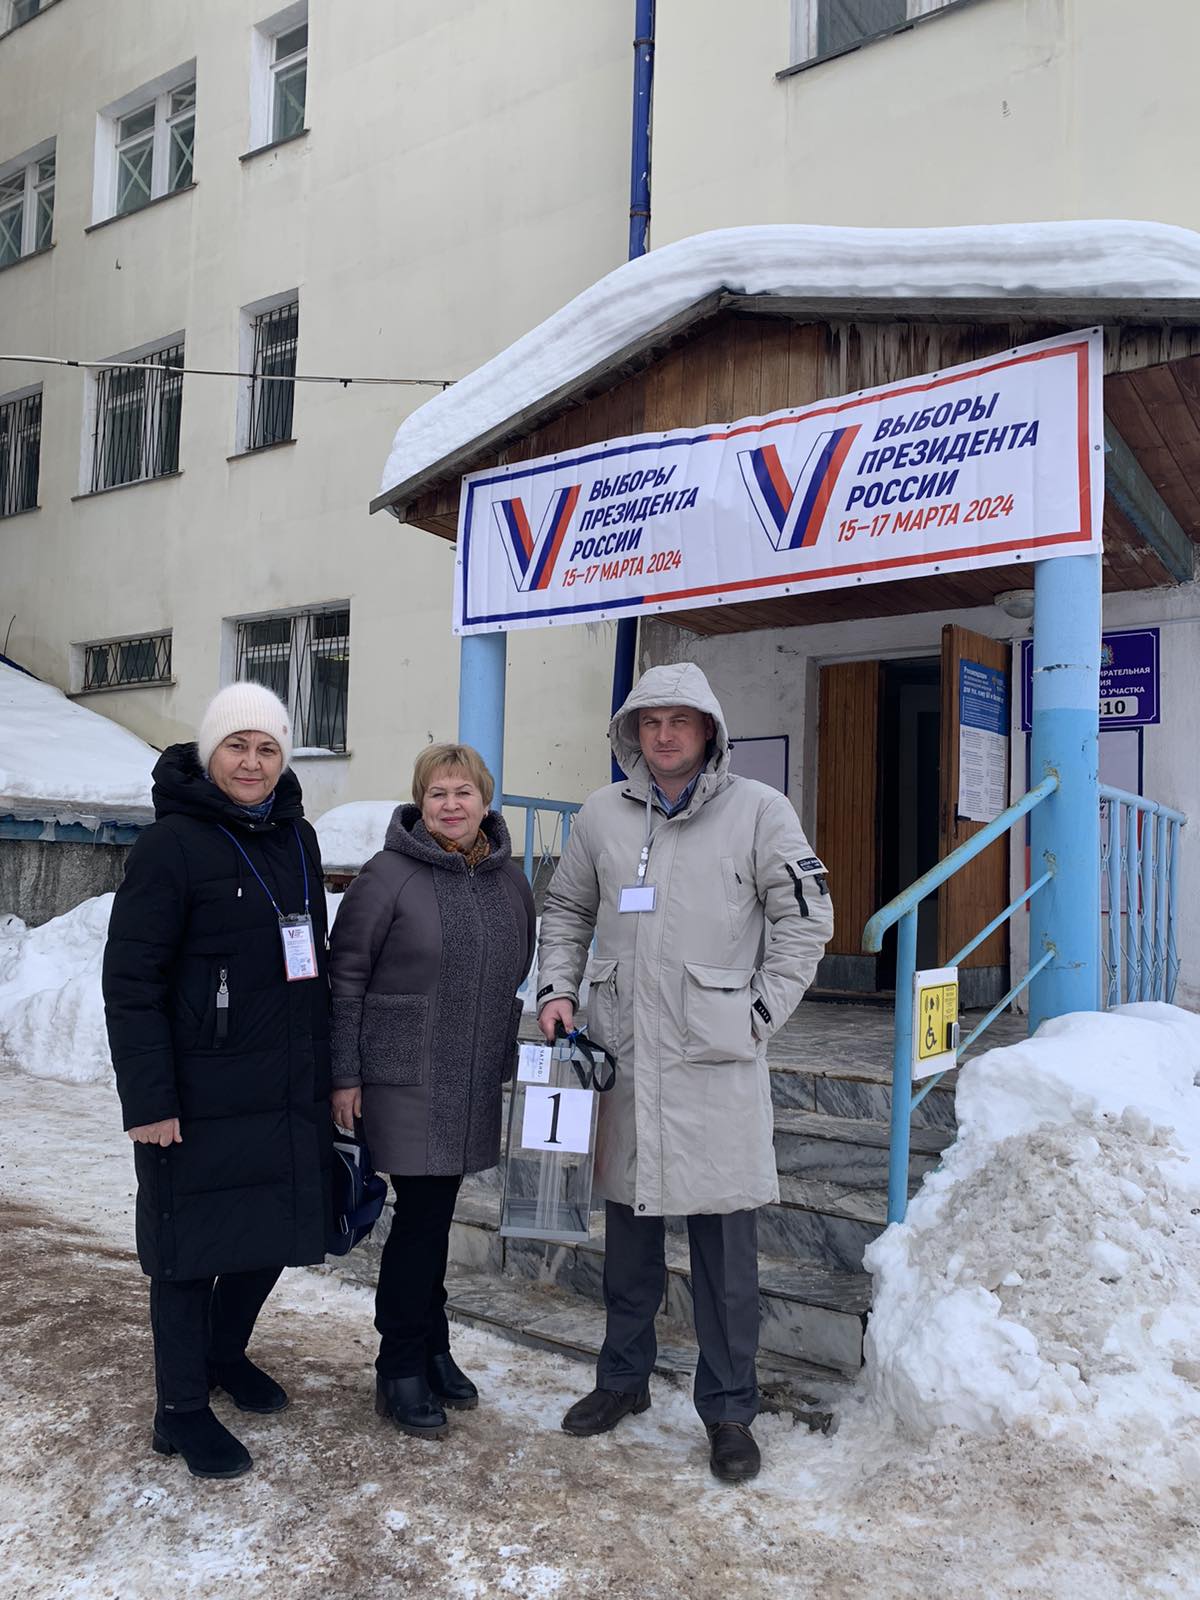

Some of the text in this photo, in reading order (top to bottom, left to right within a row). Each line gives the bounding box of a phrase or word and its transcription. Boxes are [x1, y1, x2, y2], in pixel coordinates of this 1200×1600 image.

[872, 392, 1000, 442] ВЫБОРЫ
[857, 420, 1040, 476] ПРЕЗИДЕНТА
[588, 464, 678, 502] ВЫБОРЫ
[845, 469, 960, 512] РОССИИ
[578, 486, 699, 532] ПРЕЗИДЕНТА
[892, 502, 960, 534] МАРТА
[963, 494, 1014, 522] 2024
[569, 527, 643, 562] РОССИИ
[600, 555, 644, 583] МАРТА
[646, 549, 682, 574] 2024
[1100, 666, 1151, 677] ИРАТЕЛЬНАЯ
[1108, 686, 1145, 696] УЧАСТКА
[543, 1092, 562, 1144] 1
